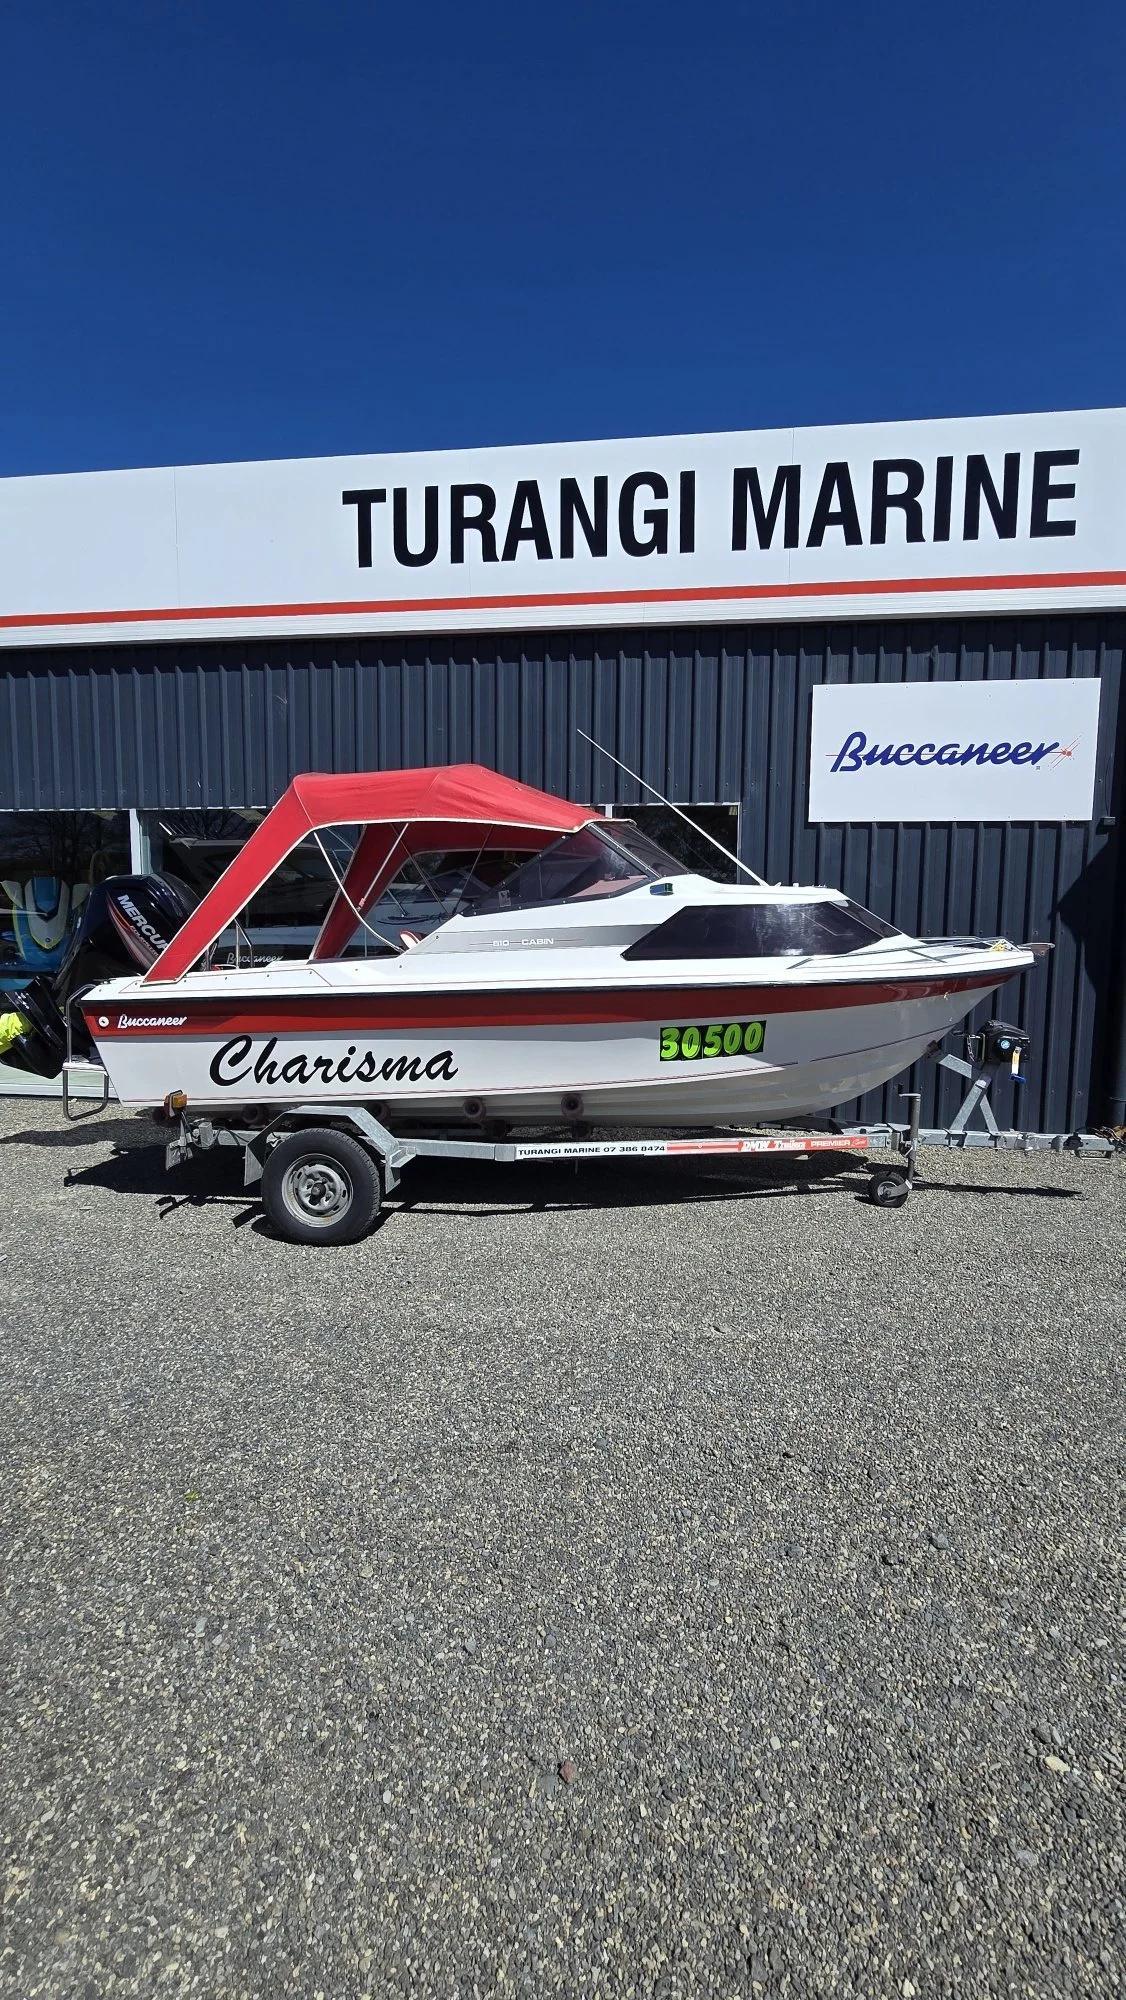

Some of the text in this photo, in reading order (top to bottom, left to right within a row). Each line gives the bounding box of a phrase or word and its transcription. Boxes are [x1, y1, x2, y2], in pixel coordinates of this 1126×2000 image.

[342, 448, 1080, 568] TURANGI MARINE
[830, 731, 1060, 773] Buccaneer
[117, 894, 169, 950] MERCU
[521, 938, 554, 946] CABIN
[117, 1013, 187, 1029] Buccaneer
[660, 1022, 764, 1060] 30500
[209, 1034, 459, 1087] Charisma
[518, 1148, 561, 1156] TURANGI
